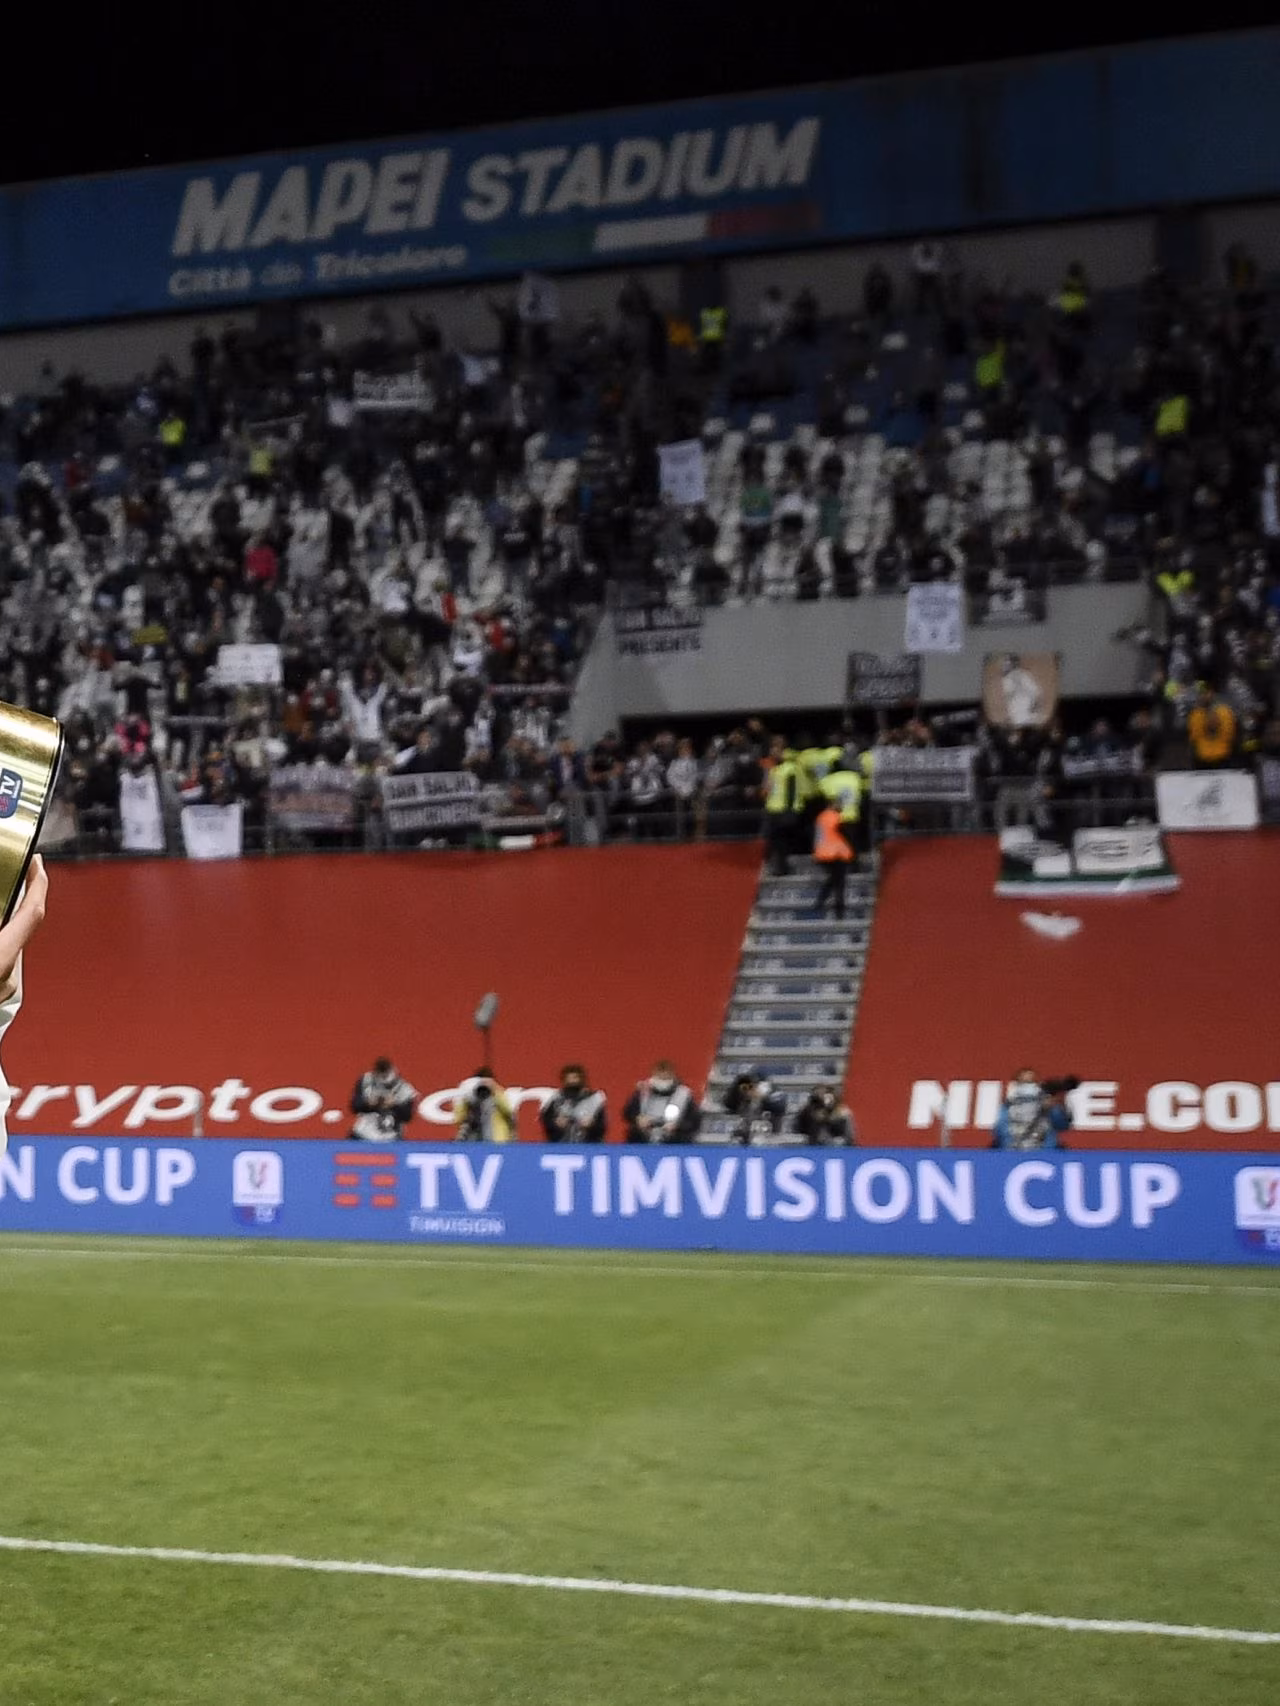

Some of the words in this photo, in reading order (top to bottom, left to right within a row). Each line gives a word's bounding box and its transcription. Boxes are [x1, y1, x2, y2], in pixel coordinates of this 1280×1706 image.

[172, 148, 451, 256] MAPEI
[463, 116, 820, 222] STADIUM
[0, 775, 15, 795] TV
[907, 1079, 1280, 1133] NIE.CO
[57, 1145, 196, 1206] CUP
[406, 1153, 504, 1212] TV
[540, 1153, 976, 1225] TIMVISION
[1004, 1160, 1182, 1229] CUP
[409, 1215, 505, 1236] TIMVISION
